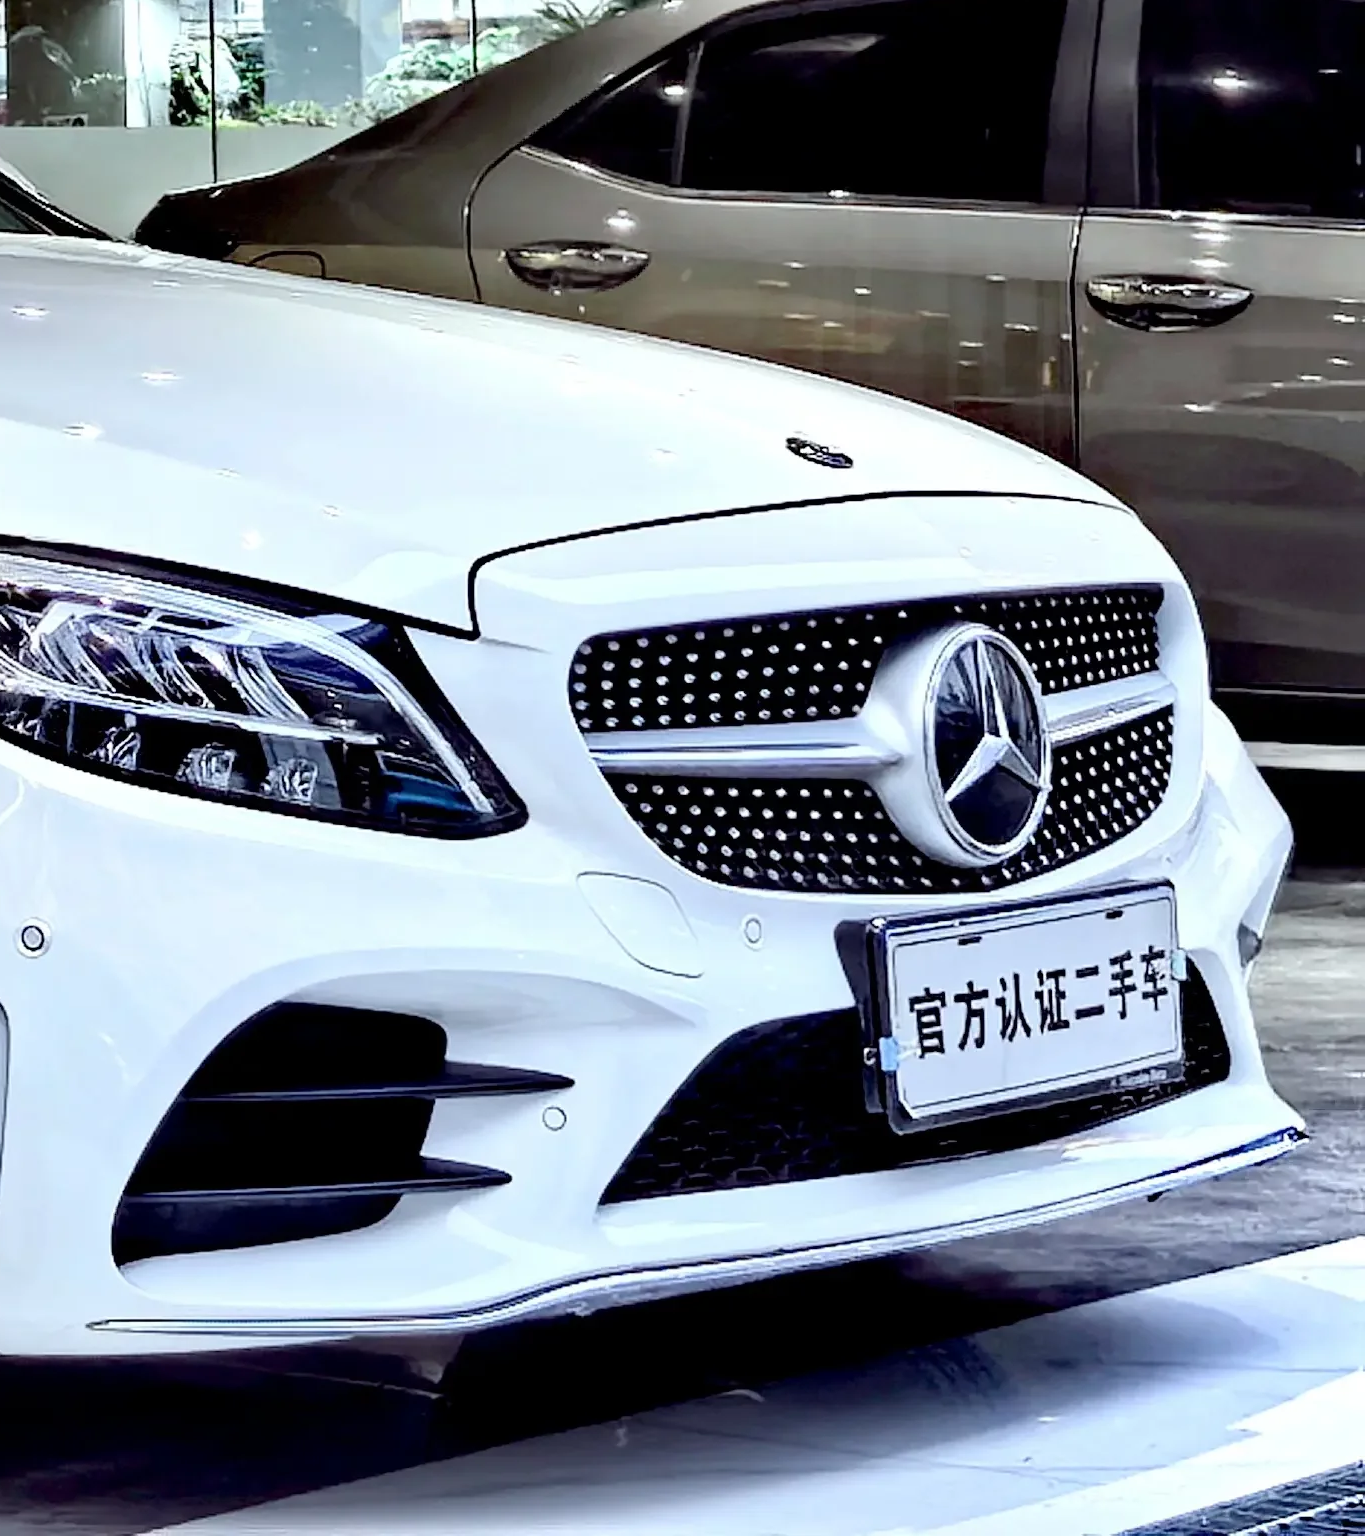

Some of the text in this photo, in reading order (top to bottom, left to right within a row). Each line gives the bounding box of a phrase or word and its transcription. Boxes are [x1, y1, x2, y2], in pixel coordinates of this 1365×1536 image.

[908, 945, 1169, 1059] 官方认证二手车
